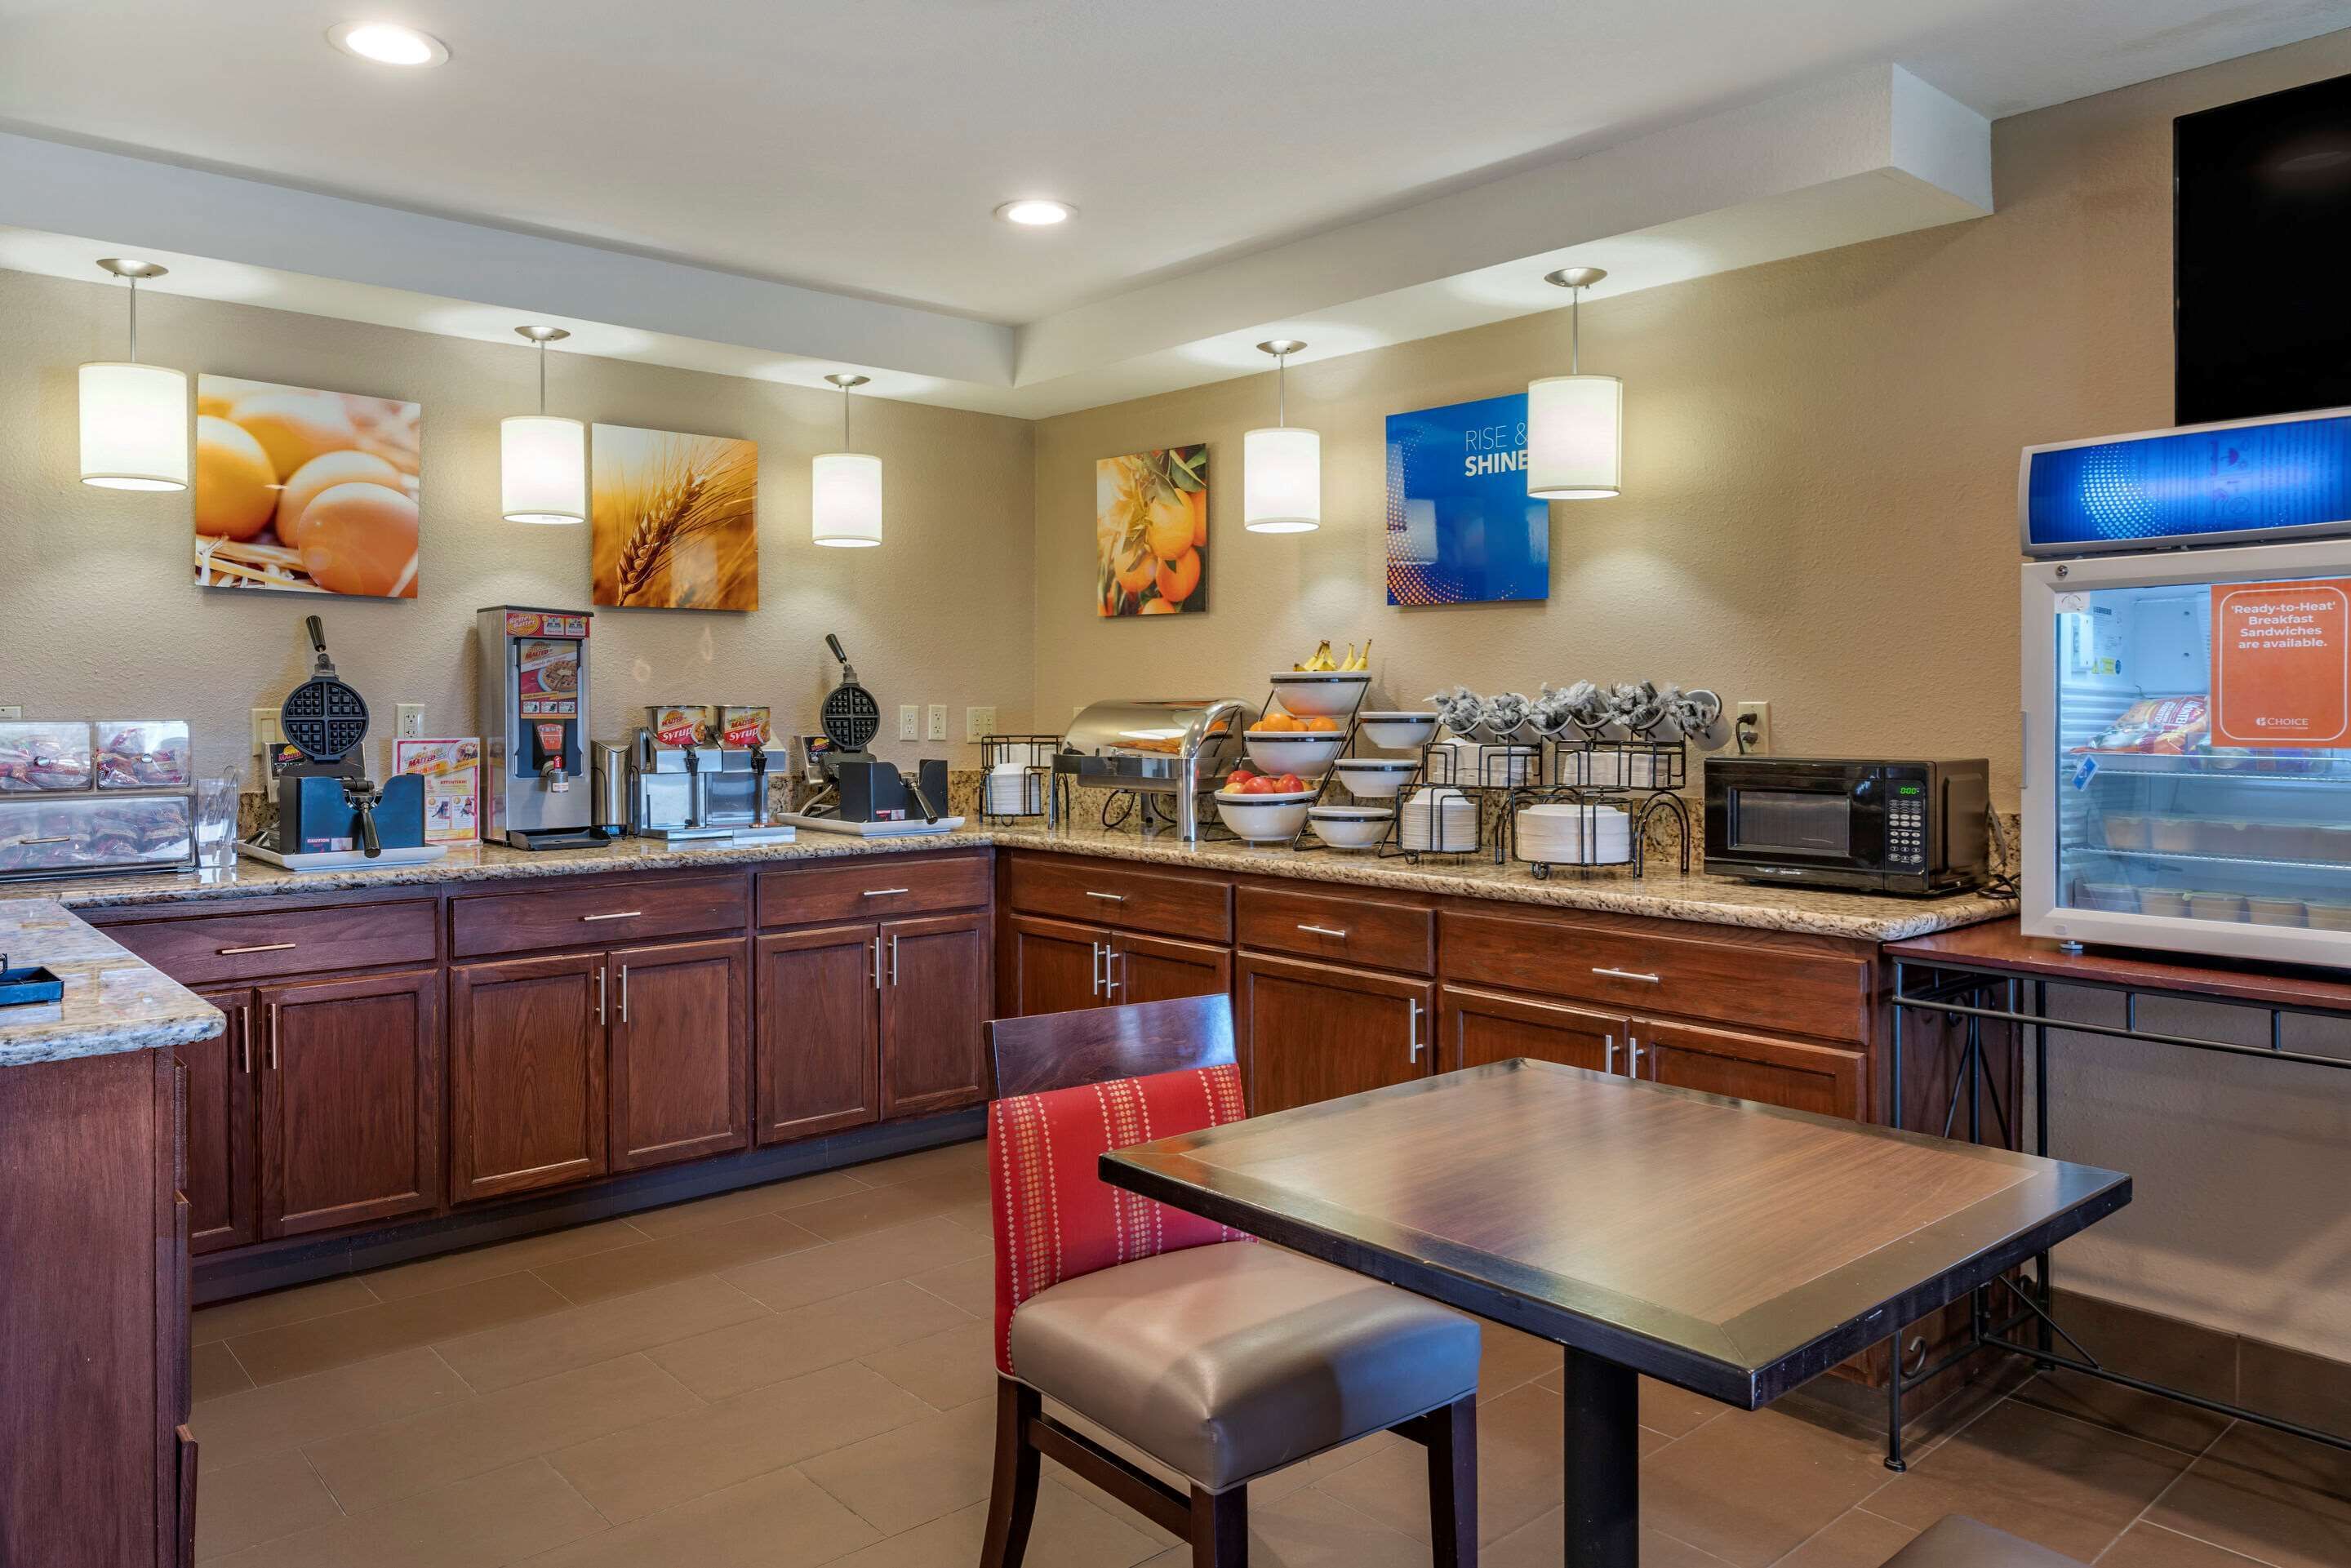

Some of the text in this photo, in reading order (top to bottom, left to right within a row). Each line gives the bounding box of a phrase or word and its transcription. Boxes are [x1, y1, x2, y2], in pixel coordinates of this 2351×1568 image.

[1465, 423, 1528, 451] RISE &
[1464, 449, 1528, 477] SHINE
[2231, 601, 2335, 614] 'Ready-to-Heat'
[2248, 615, 2314, 625] Breakfast
[2240, 626, 2322, 637] Sandwiches
[2238, 637, 2327, 649] are available.
[2267, 717, 2309, 726] CHOICE
[662, 727, 692, 741] Syrup
[728, 727, 758, 741] Syrup
